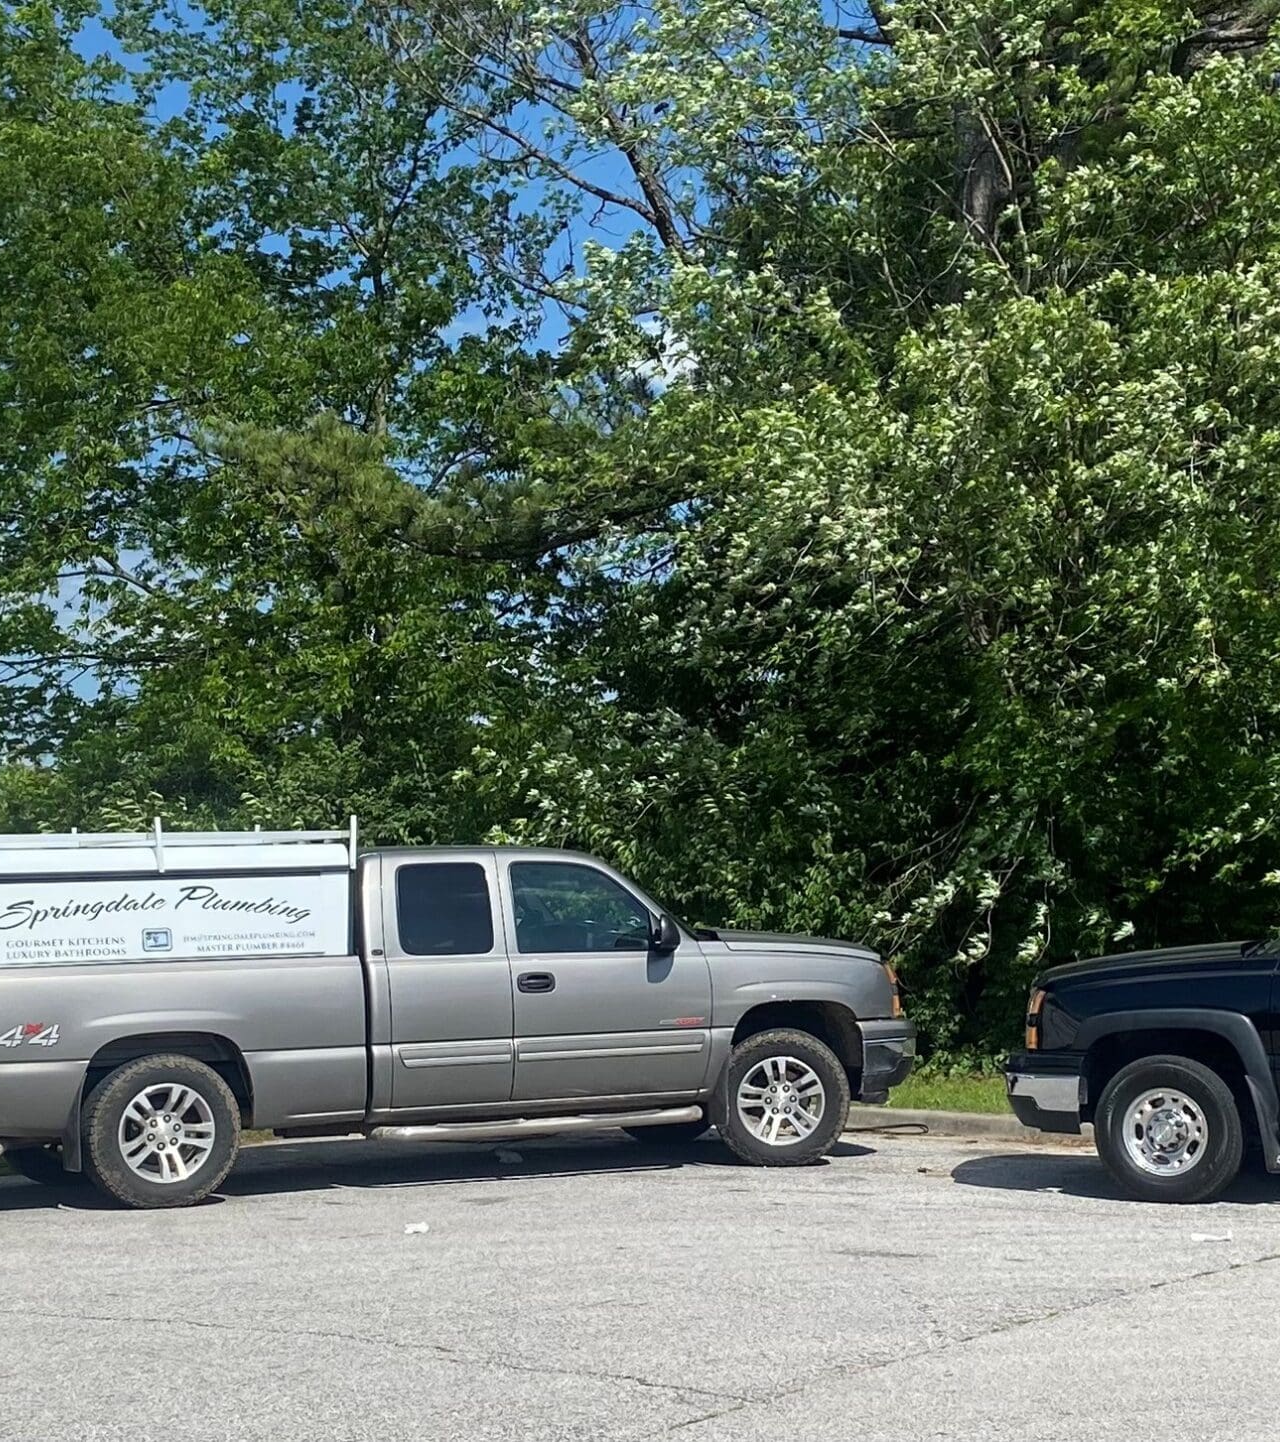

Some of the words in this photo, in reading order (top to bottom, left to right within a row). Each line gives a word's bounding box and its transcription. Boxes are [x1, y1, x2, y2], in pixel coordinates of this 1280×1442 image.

[174, 885, 312, 925] Plumbing
[6, 937, 66, 949] GOURMET
[68, 936, 127, 947] KITCHENS
[196, 942, 235, 953] MASTER
[235, 941, 278, 952] PLUMBER
[6, 949, 52, 961] LUXURY
[54, 947, 127, 960] BATHROOMS
